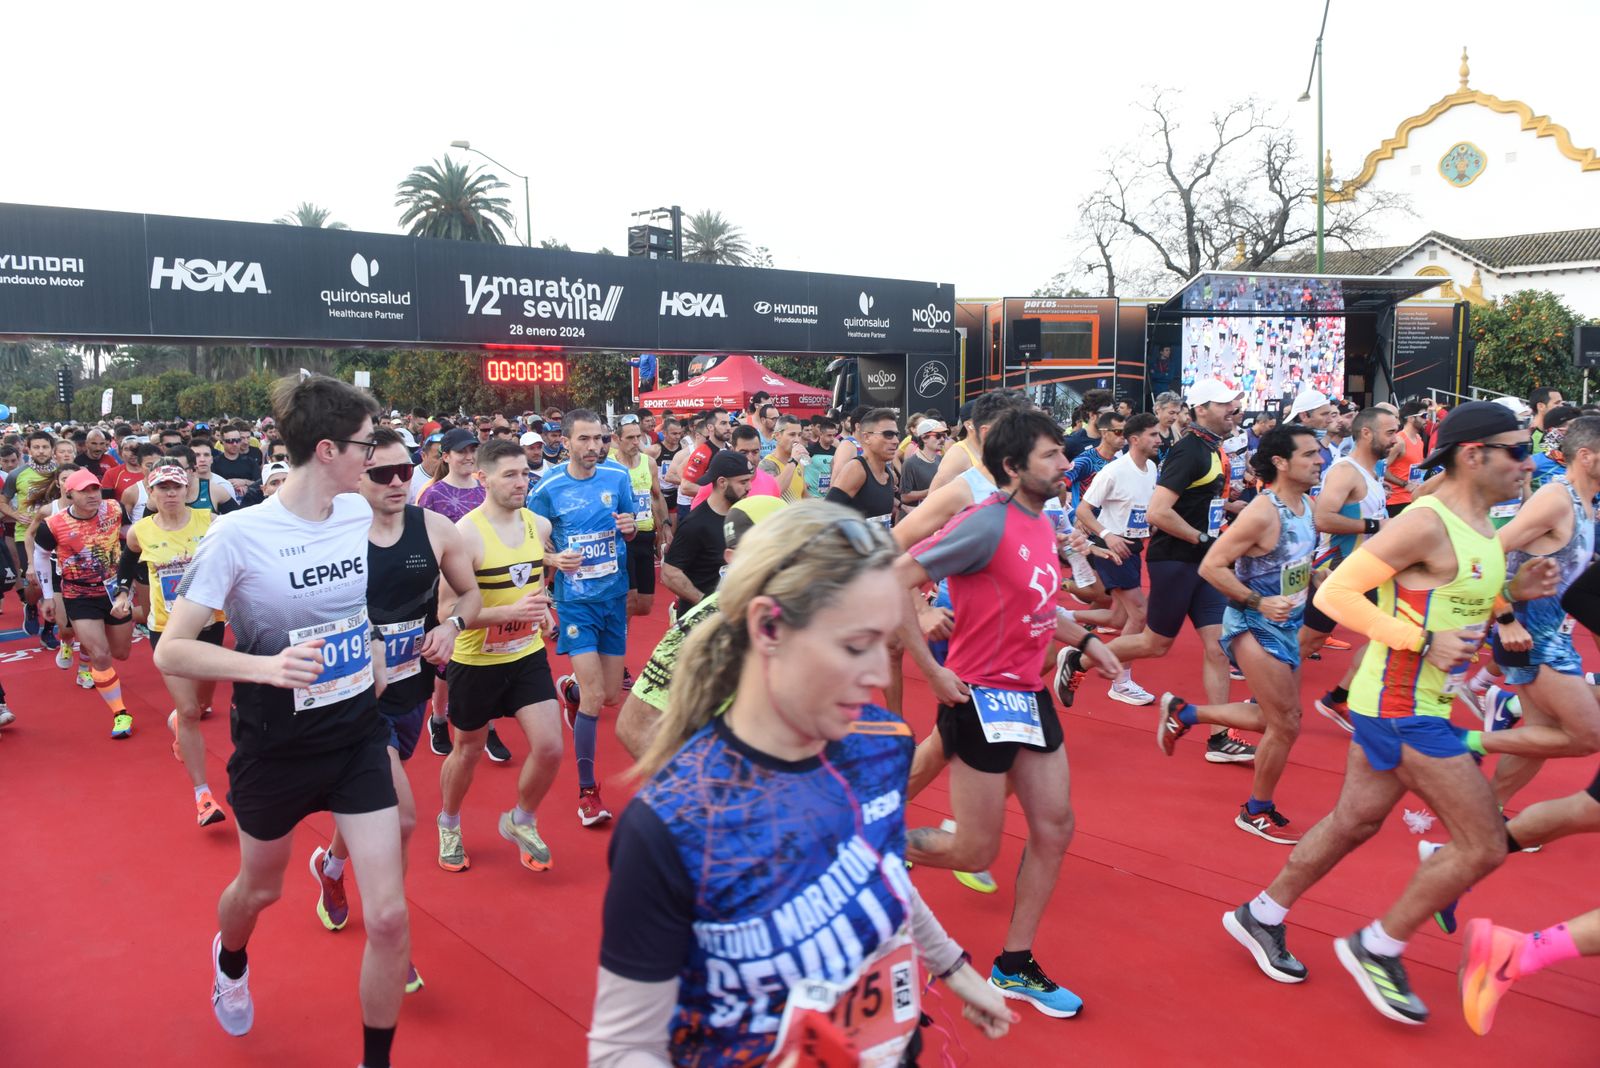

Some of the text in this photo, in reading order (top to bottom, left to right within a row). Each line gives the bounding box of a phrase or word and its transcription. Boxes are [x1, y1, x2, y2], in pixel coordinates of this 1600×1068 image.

[49, 276, 85, 287] Motor
[150, 256, 268, 294] HOKA
[320, 288, 411, 306] quirónsalud
[493, 276, 601, 301] maratón
[328, 308, 405, 320] Healthcare Partner
[523, 297, 603, 321] sevilla
[659, 290, 726, 318] HOKA
[774, 303, 818, 316] HYUNDAI
[509, 324, 586, 338] 28 enero 2024
[774, 316, 818, 325] Hyundauto Motor
[870, 331, 886, 339] Partner
[487, 360, 564, 382] 00:00:30
[289, 556, 364, 590] LEPAPE
[320, 635, 362, 667] 019
[384, 636, 410, 657] 17
[985, 691, 1028, 713] 3106
[829, 972, 883, 1028] 75
